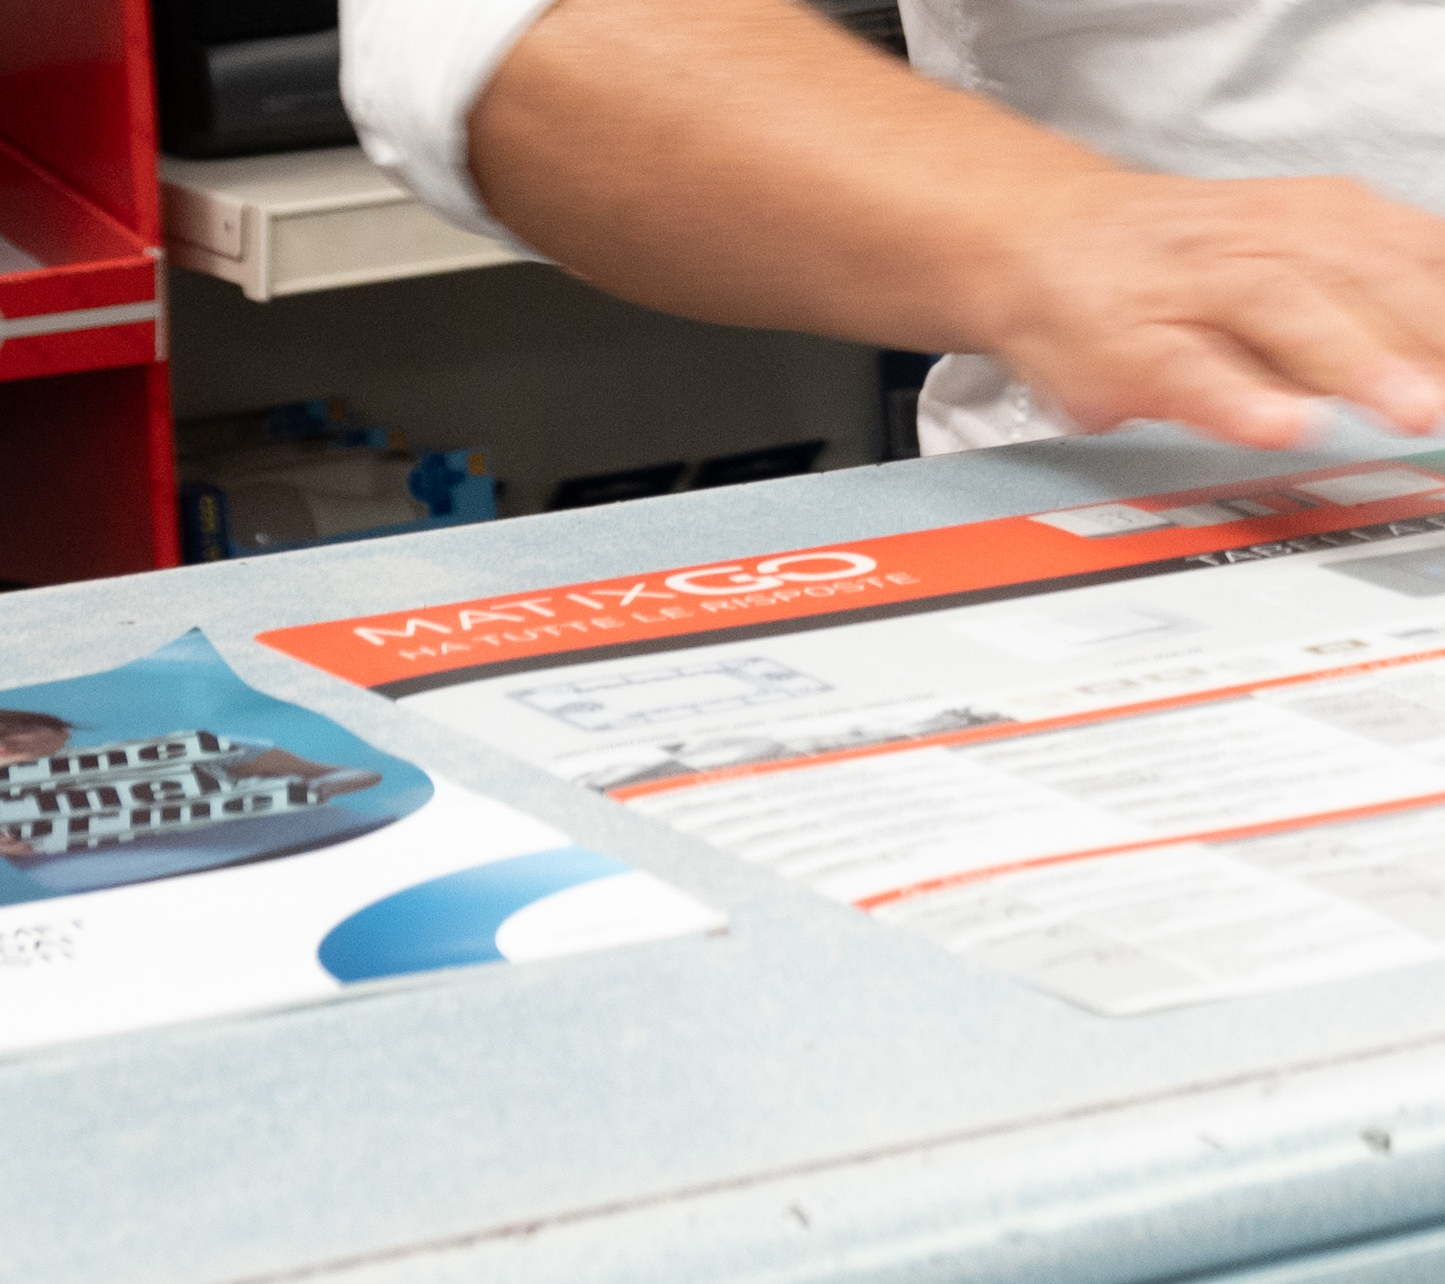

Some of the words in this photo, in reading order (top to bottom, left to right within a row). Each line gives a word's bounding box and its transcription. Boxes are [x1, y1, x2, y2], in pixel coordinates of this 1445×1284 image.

[354, 551, 877, 647] MATIXGO
[472, 614, 625, 648] TUTTE
[628, 604, 696, 624] LE
[698, 571, 922, 614] RISPOSTE
